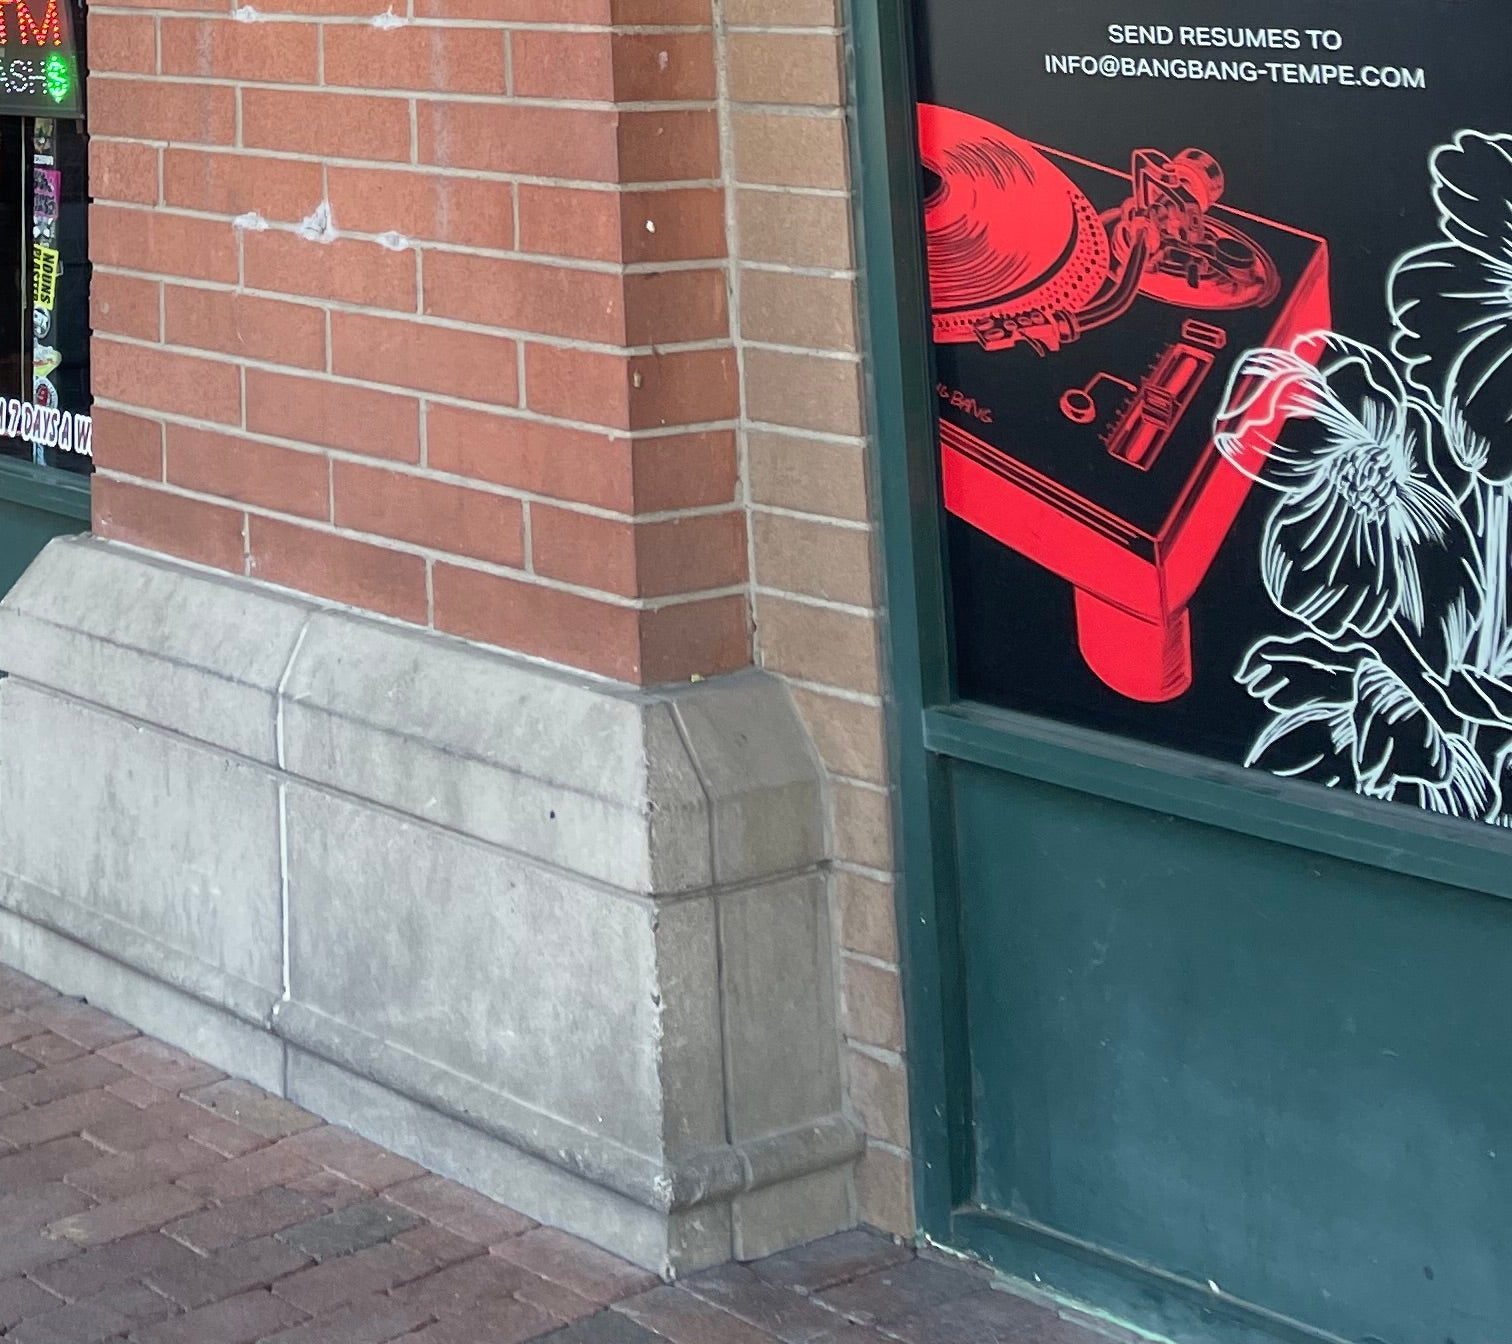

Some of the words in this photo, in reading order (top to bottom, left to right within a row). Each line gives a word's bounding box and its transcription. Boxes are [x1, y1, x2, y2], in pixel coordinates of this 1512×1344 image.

[1108, 24, 1173, 46] SEND
[1180, 26, 1300, 50] RESUMES
[1305, 28, 1342, 51] TO
[1044, 54, 1426, 89] INFO@BANGBANG-TEMPE.COM
[40, 252, 54, 304] NOUNS
[8, 399, 22, 438] 7
[22, 403, 58, 447] DAYS
[59, 411, 72, 451] A
